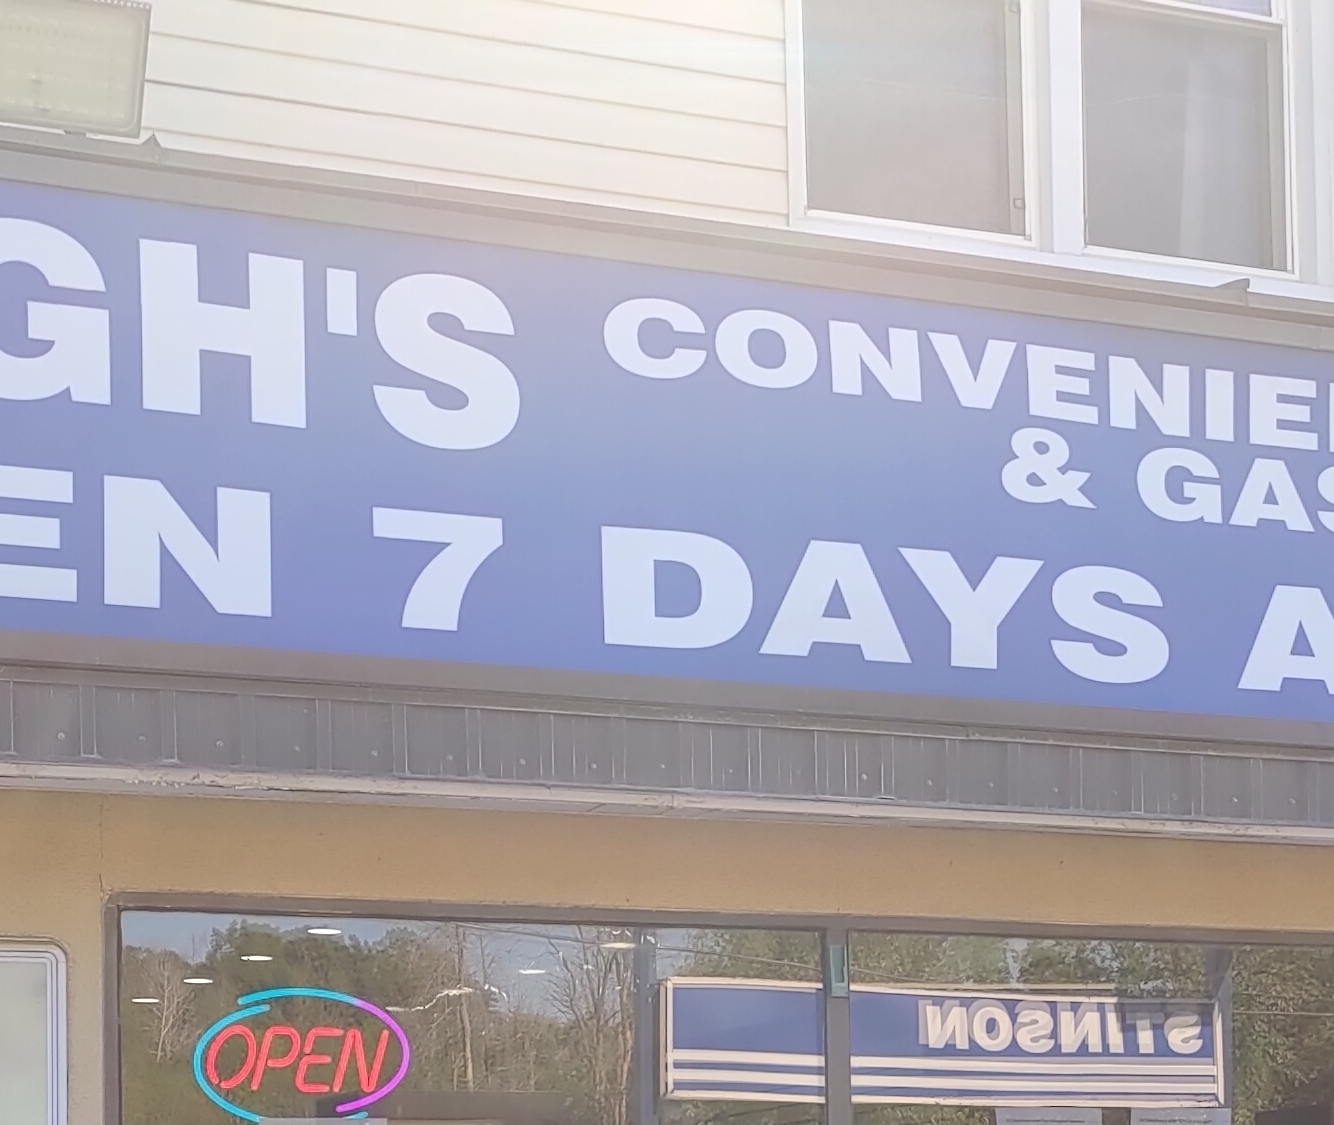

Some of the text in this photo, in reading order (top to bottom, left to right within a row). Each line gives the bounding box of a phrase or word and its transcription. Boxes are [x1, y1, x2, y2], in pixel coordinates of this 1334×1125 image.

[1001, 428, 1097, 510] &
[372, 507, 503, 631] 7
[602, 526, 1170, 683] DAYS
[206, 1024, 390, 1092] OPEN
